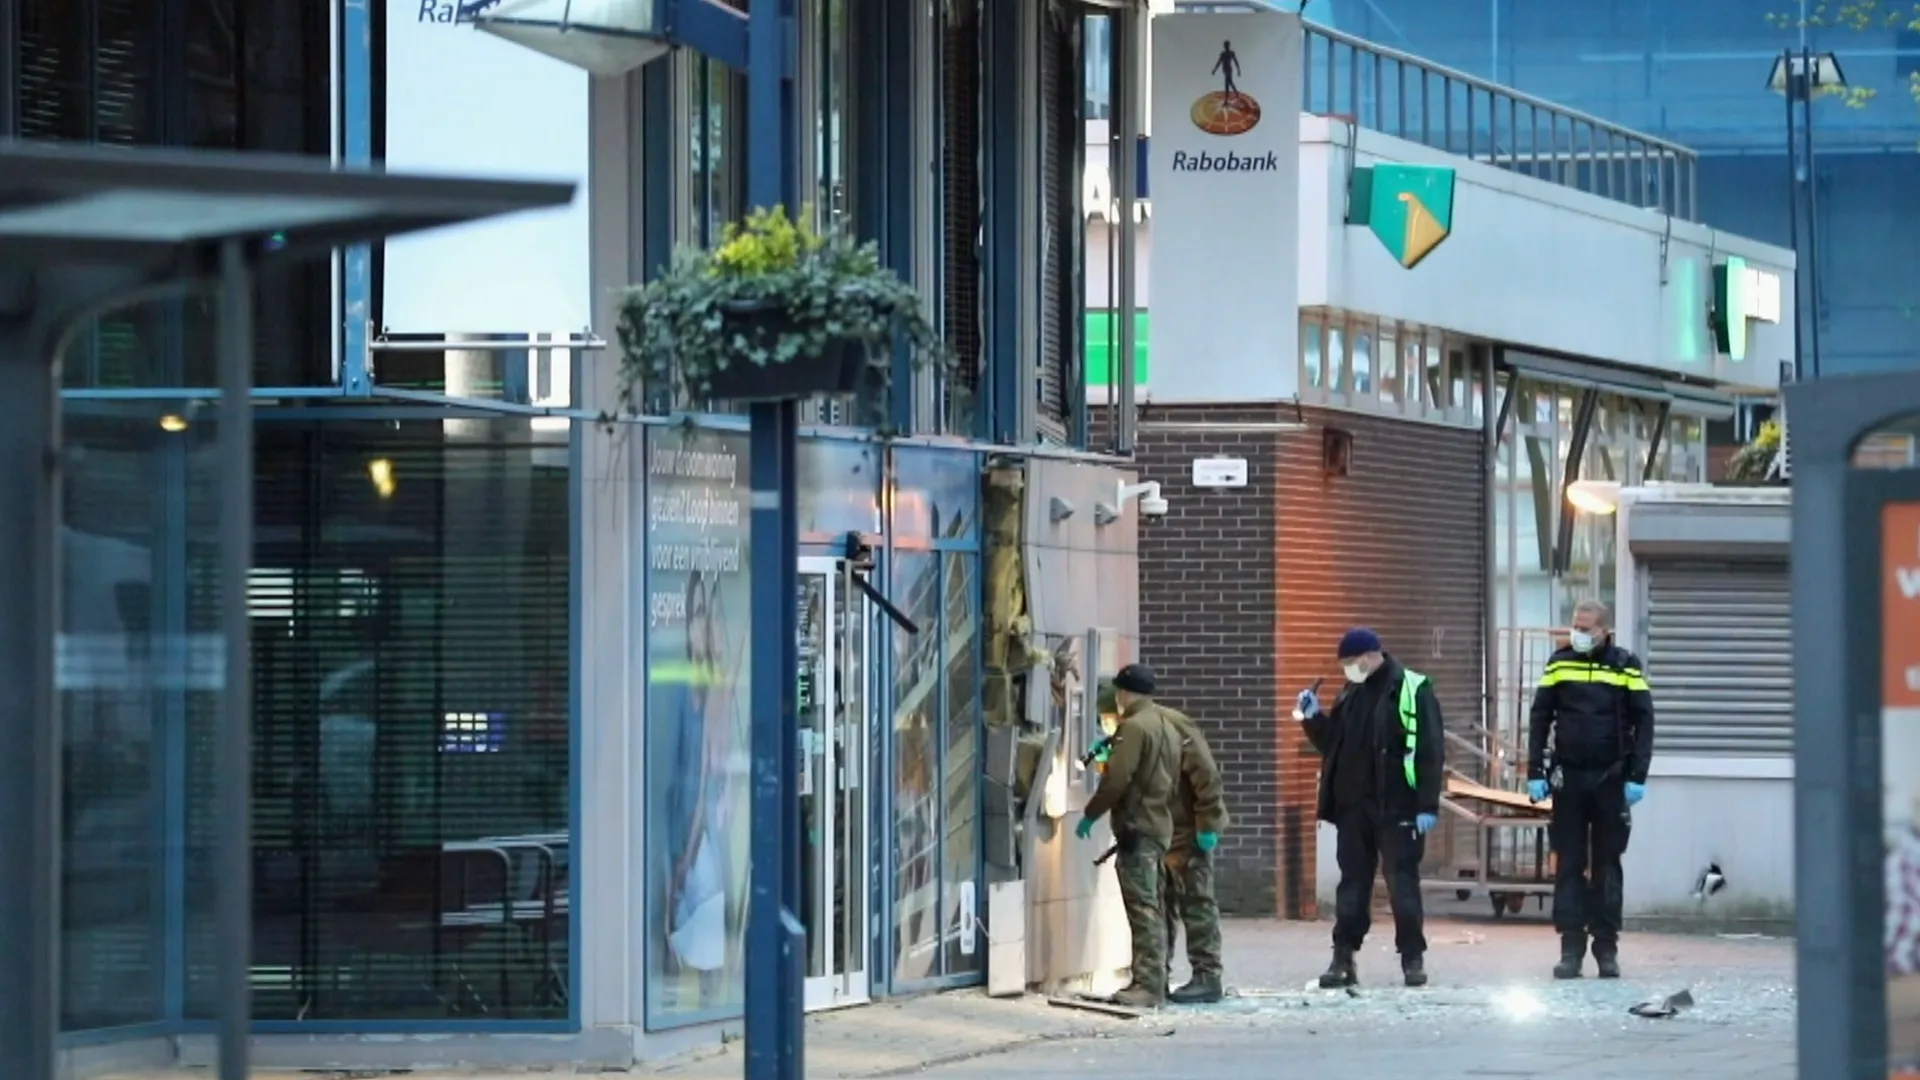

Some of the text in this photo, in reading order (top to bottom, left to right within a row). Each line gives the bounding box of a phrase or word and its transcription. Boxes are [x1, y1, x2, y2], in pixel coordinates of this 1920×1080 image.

[1172, 150, 1278, 172] Rabobank
[651, 543, 672, 570] voor
[673, 543, 690, 571] een
[651, 581, 687, 627] gesprek
